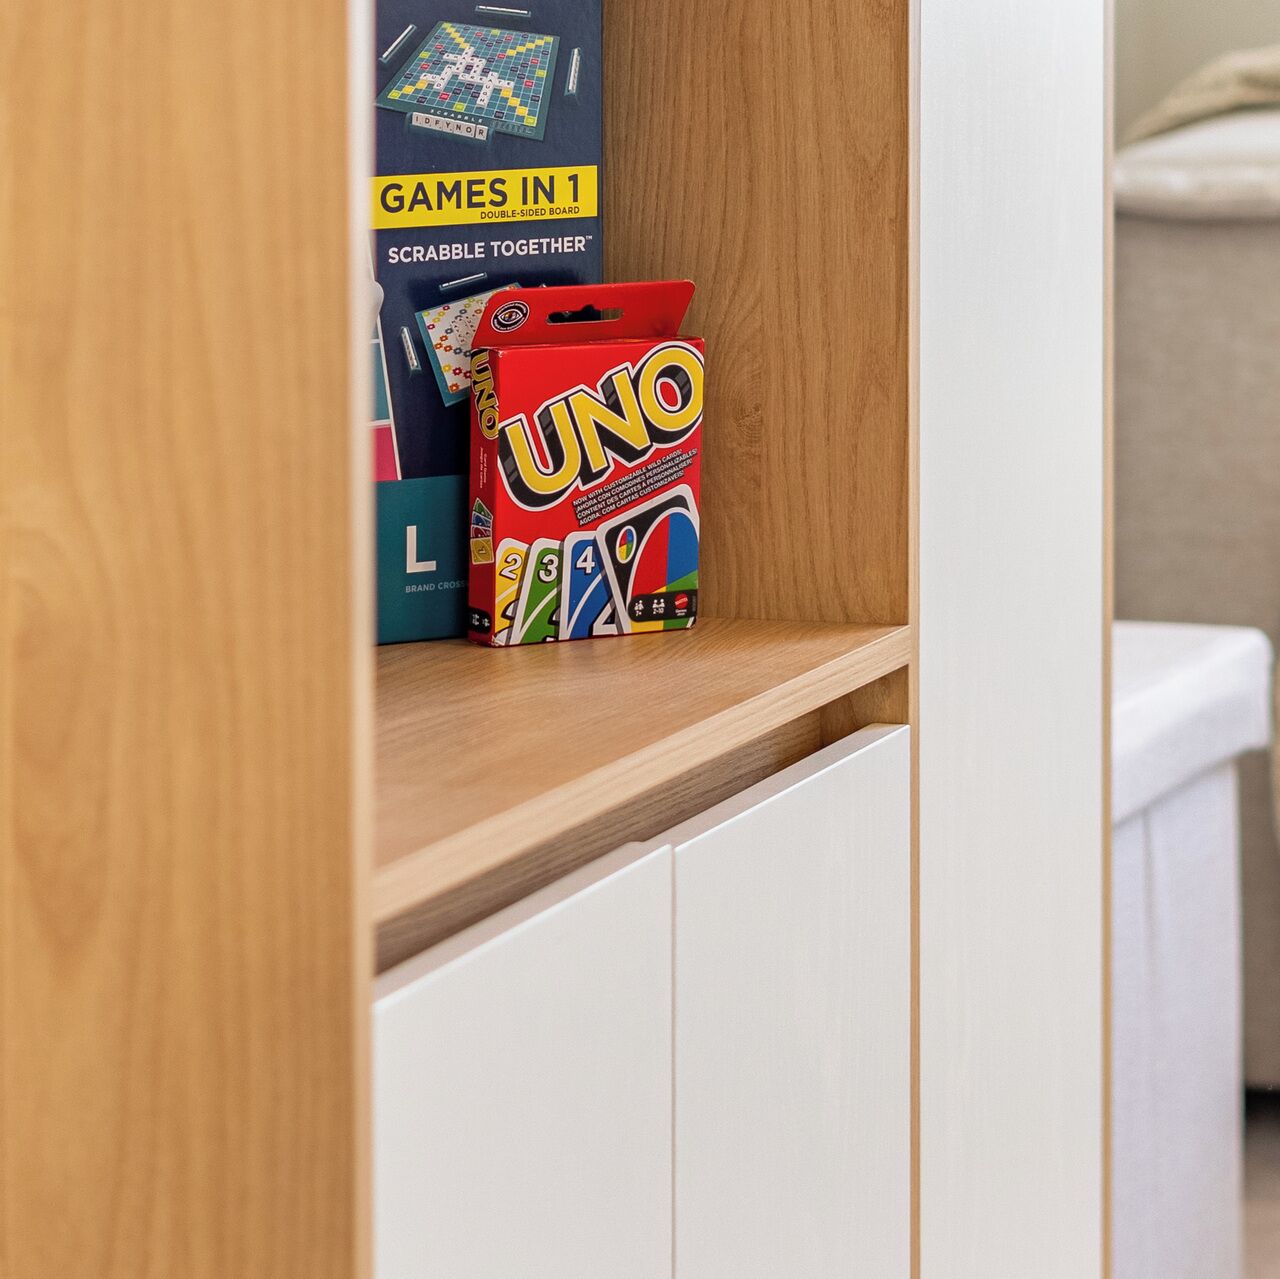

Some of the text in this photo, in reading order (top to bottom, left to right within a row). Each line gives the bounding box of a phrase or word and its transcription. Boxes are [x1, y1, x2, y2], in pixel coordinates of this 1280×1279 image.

[380, 173, 579, 213] GAMES IN 1
[480, 206, 580, 220] DOUBLE-SIDED BOARD
[388, 242, 486, 264] SCRABBLE
[470, 349, 499, 440] UNO
[498, 341, 704, 511] UNO
[573, 495, 588, 506] NOW
[588, 488, 604, 499] WITH
[603, 466, 647, 492] CUSTOMIZABLE
[647, 459, 662, 470] WILD
[597, 492, 612, 502] CON
[611, 475, 646, 495] COMODINES
[577, 502, 607, 519] CONTIENT
[606, 495, 619, 505] DES
[619, 484, 642, 499] CARTES
[601, 504, 616, 515] COM
[616, 493, 640, 508] CARTAS
[406, 525, 437, 573] L
[575, 546, 596, 574] 4
[500, 552, 523, 580] 2
[538, 553, 559, 583] 3
[405, 580, 467, 593] BRAND CROSS
